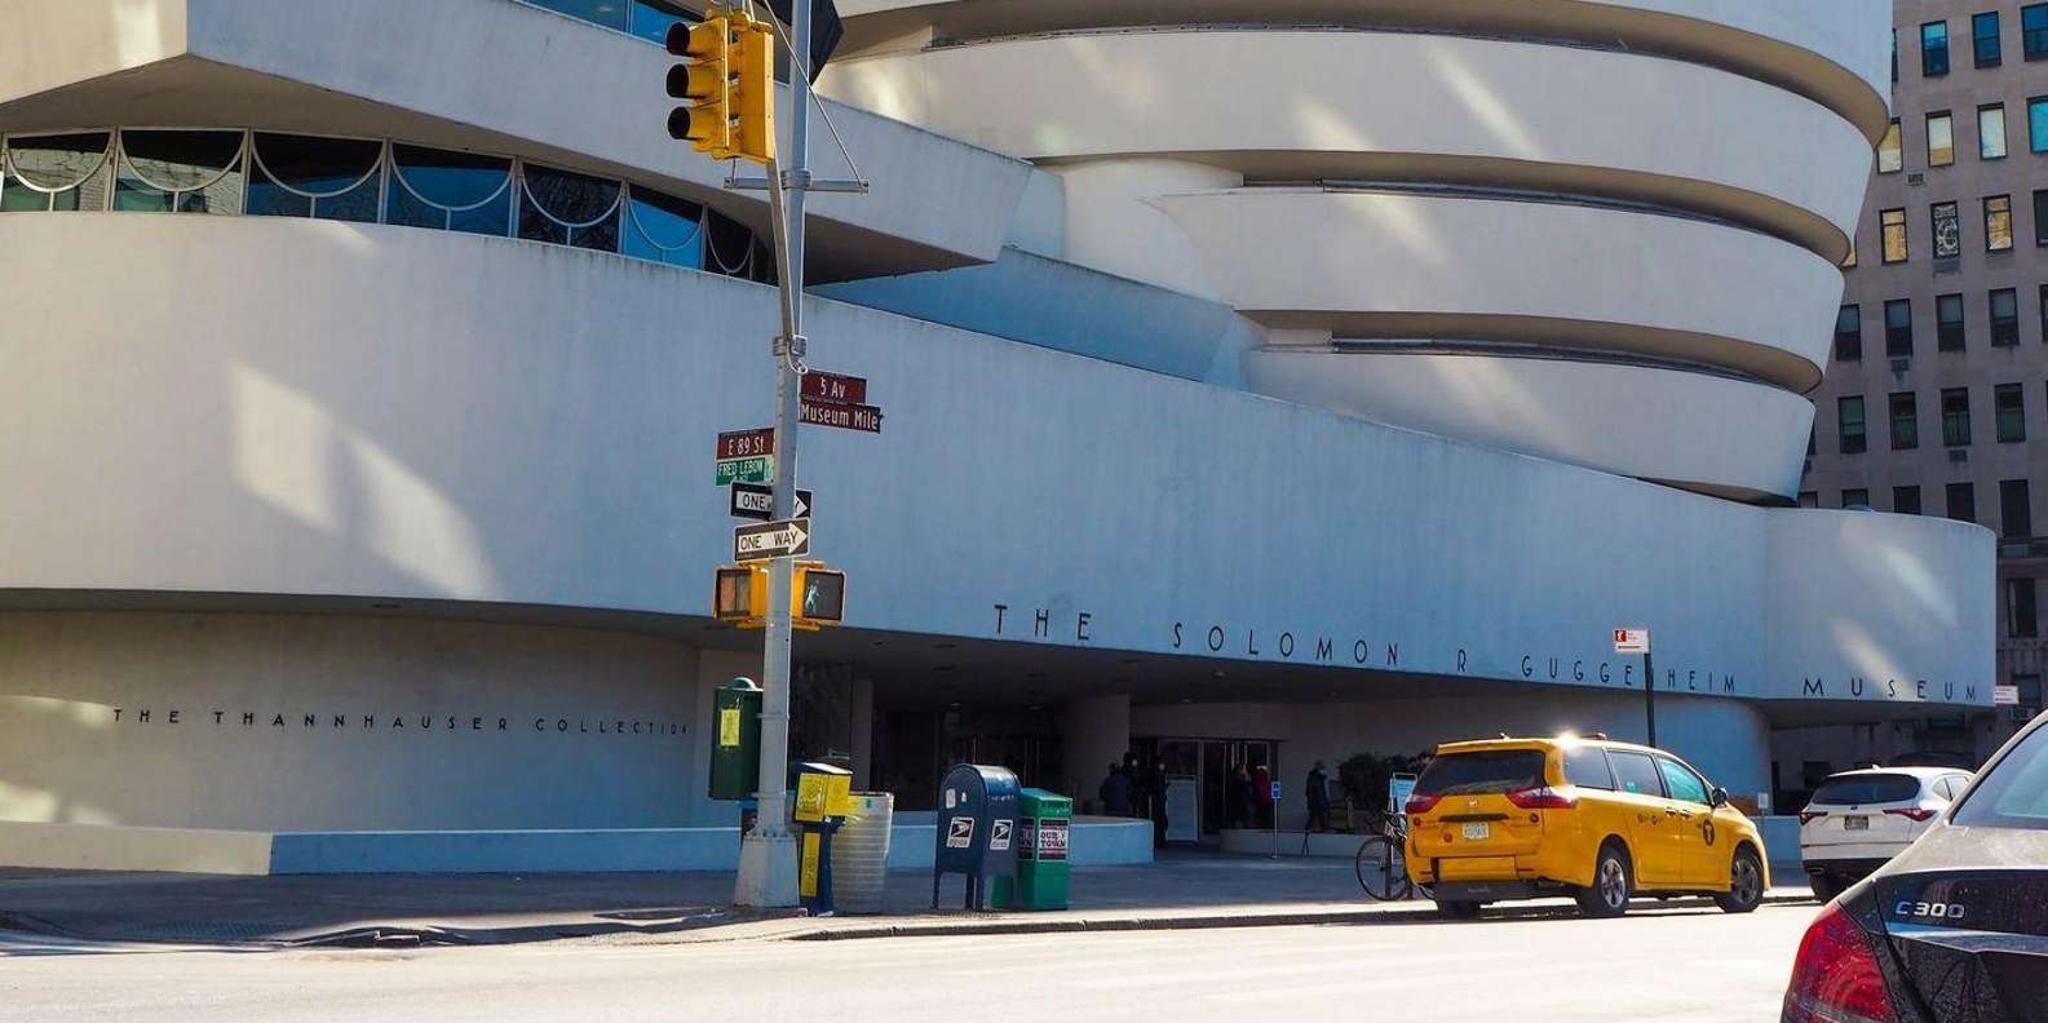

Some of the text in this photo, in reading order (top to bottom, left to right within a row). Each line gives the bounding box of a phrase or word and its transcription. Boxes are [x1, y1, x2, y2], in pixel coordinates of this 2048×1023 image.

[821, 376, 846, 398] 5 Av
[801, 403, 879, 430] Museum Mile
[728, 435, 765, 455] E 89 St
[719, 463, 738, 476] FRED
[742, 494, 766, 510] ONE
[741, 530, 798, 550] ONE WAY
[994, 604, 1976, 701] THE SOLOMON R GUGGEHEIM MUSEUM
[113, 708, 180, 724] THE
[214, 711, 508, 731] THANNHAUSER
[1896, 901, 1966, 918] C 300
